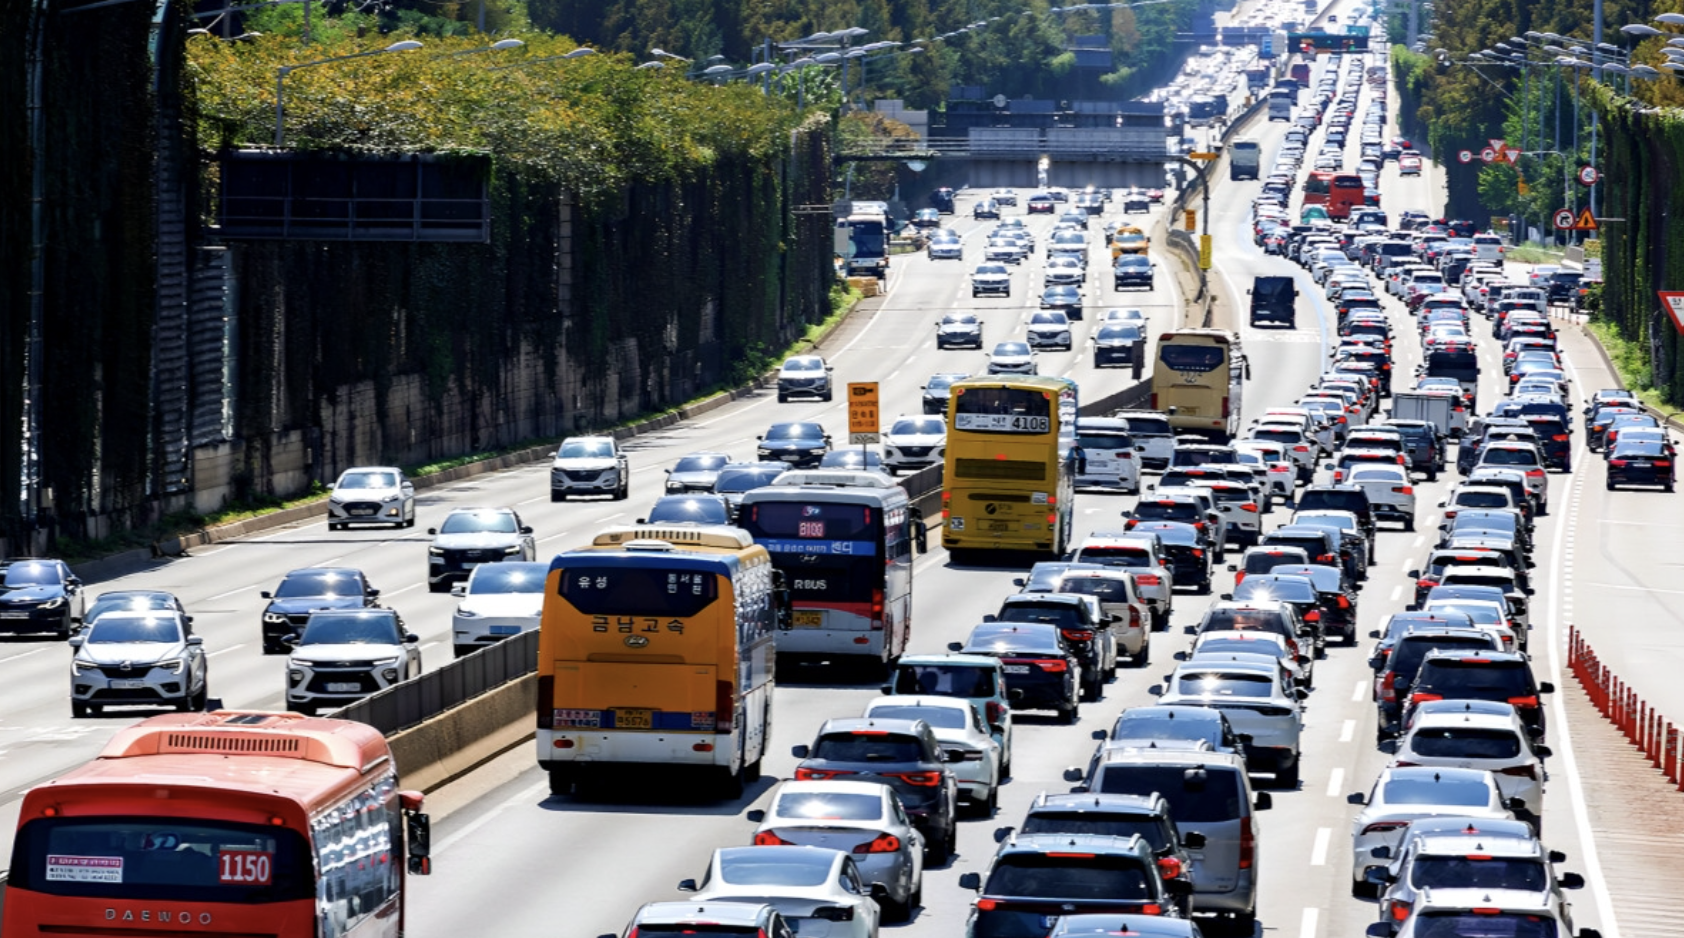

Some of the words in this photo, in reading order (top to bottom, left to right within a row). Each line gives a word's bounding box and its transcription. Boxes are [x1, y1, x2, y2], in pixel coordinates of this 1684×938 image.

[1012, 417, 1048, 430] 4108
[578, 576, 608, 589] 유성
[591, 615, 685, 635] 금남고속
[220, 854, 270, 883] 1150
[105, 908, 212, 925] DAEWOO
